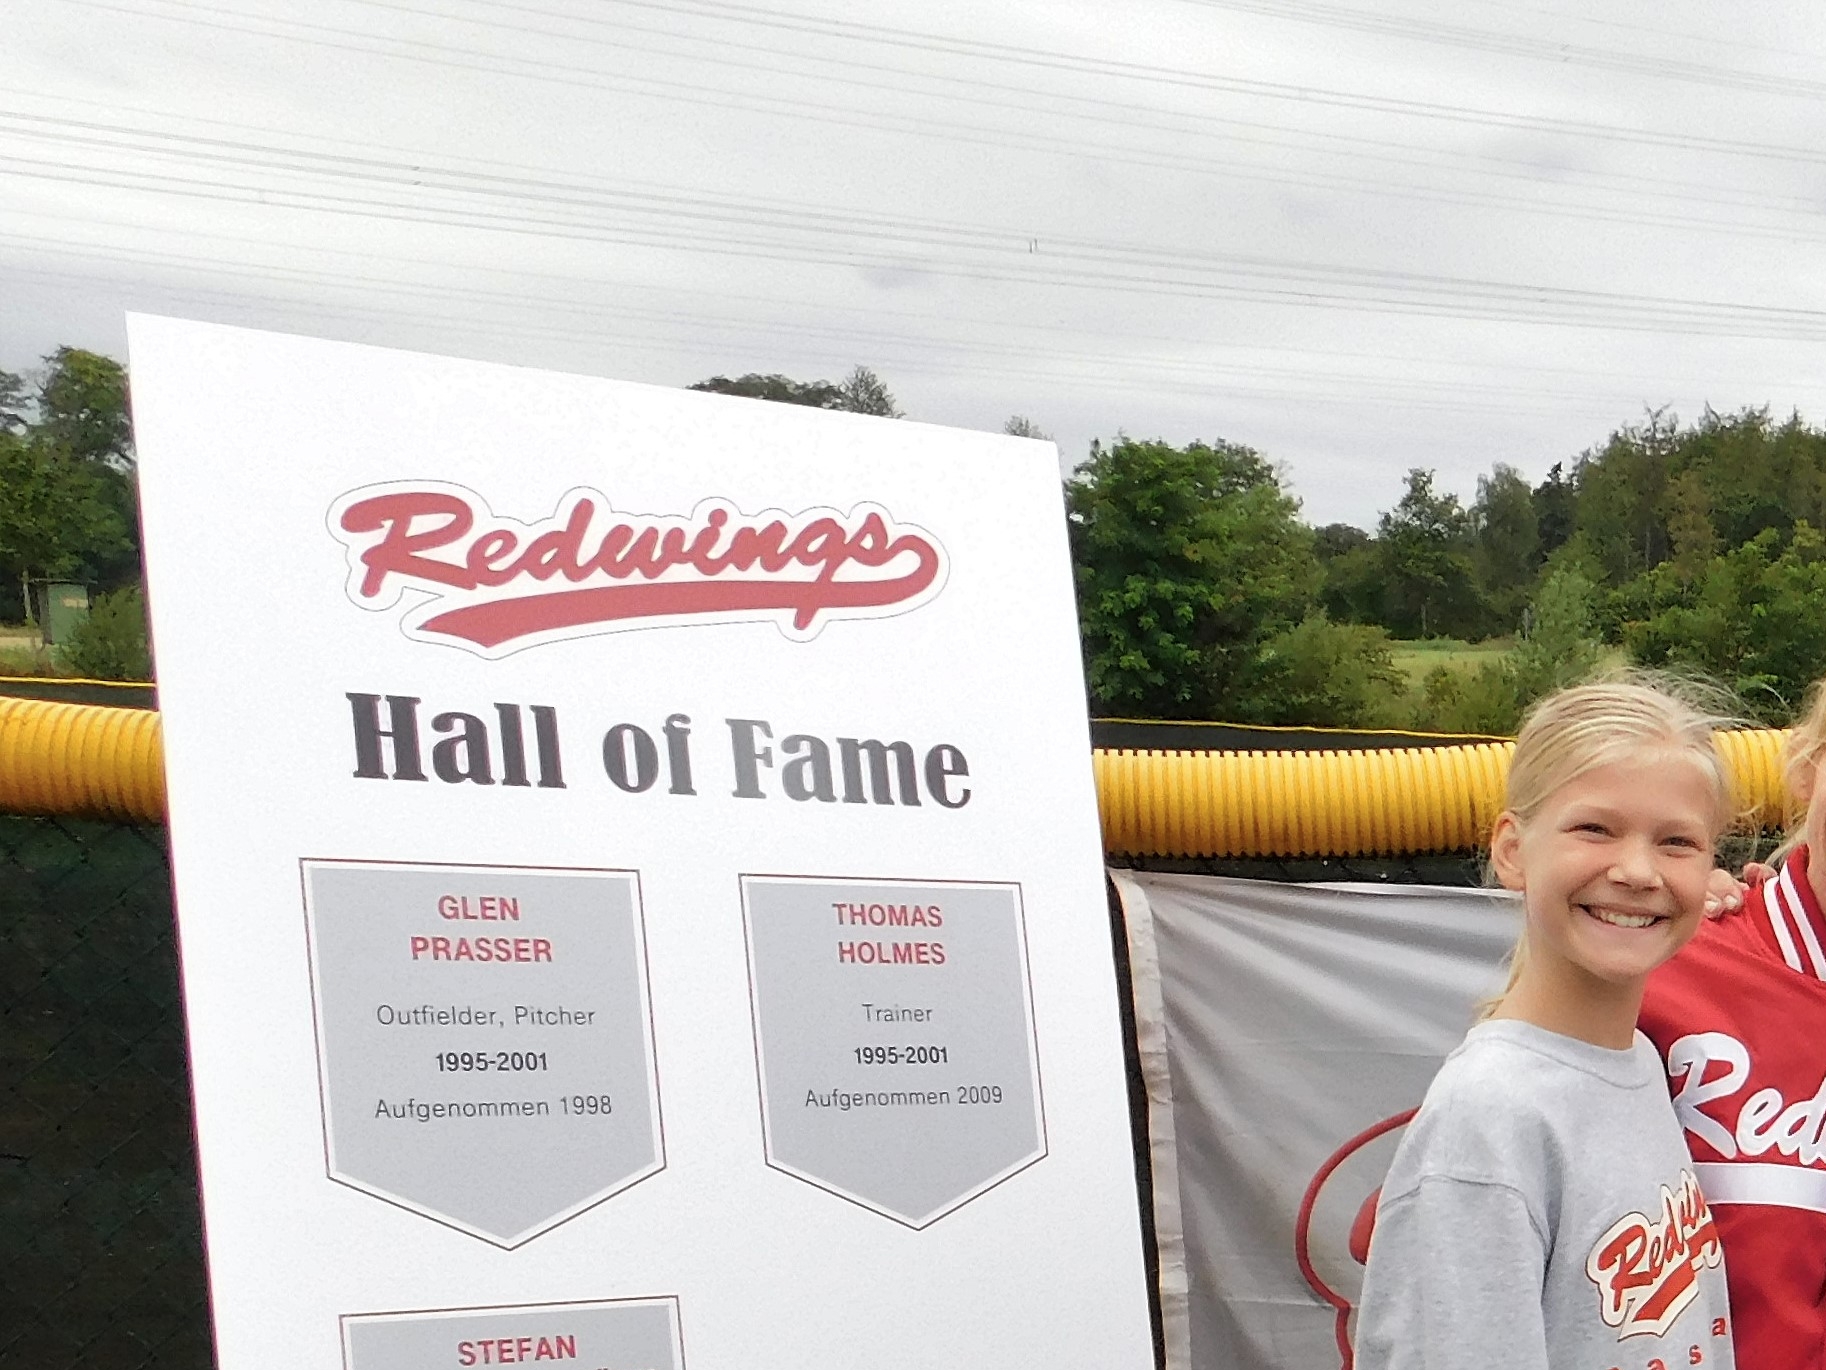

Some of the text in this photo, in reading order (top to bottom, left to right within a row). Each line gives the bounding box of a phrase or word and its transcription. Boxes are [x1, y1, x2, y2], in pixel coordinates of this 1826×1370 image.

[341, 492, 939, 636] Redwings
[345, 692, 971, 809] Hall of Fame
[437, 895, 520, 922] GLEN
[832, 903, 943, 928] THOMAS
[410, 936, 553, 963] PRASSER
[837, 942, 946, 965] HOLMES
[376, 1004, 596, 1028] Outfielder, Pitcher
[862, 1004, 933, 1023] Trainer
[435, 1052, 548, 1072] 1995-2001
[853, 1046, 949, 1064] 1995-2001
[374, 1095, 612, 1123] Aufgenommen 1998
[805, 1086, 1003, 1111] Aufgenommen 2009
[458, 1335, 577, 1366] STEFAN
